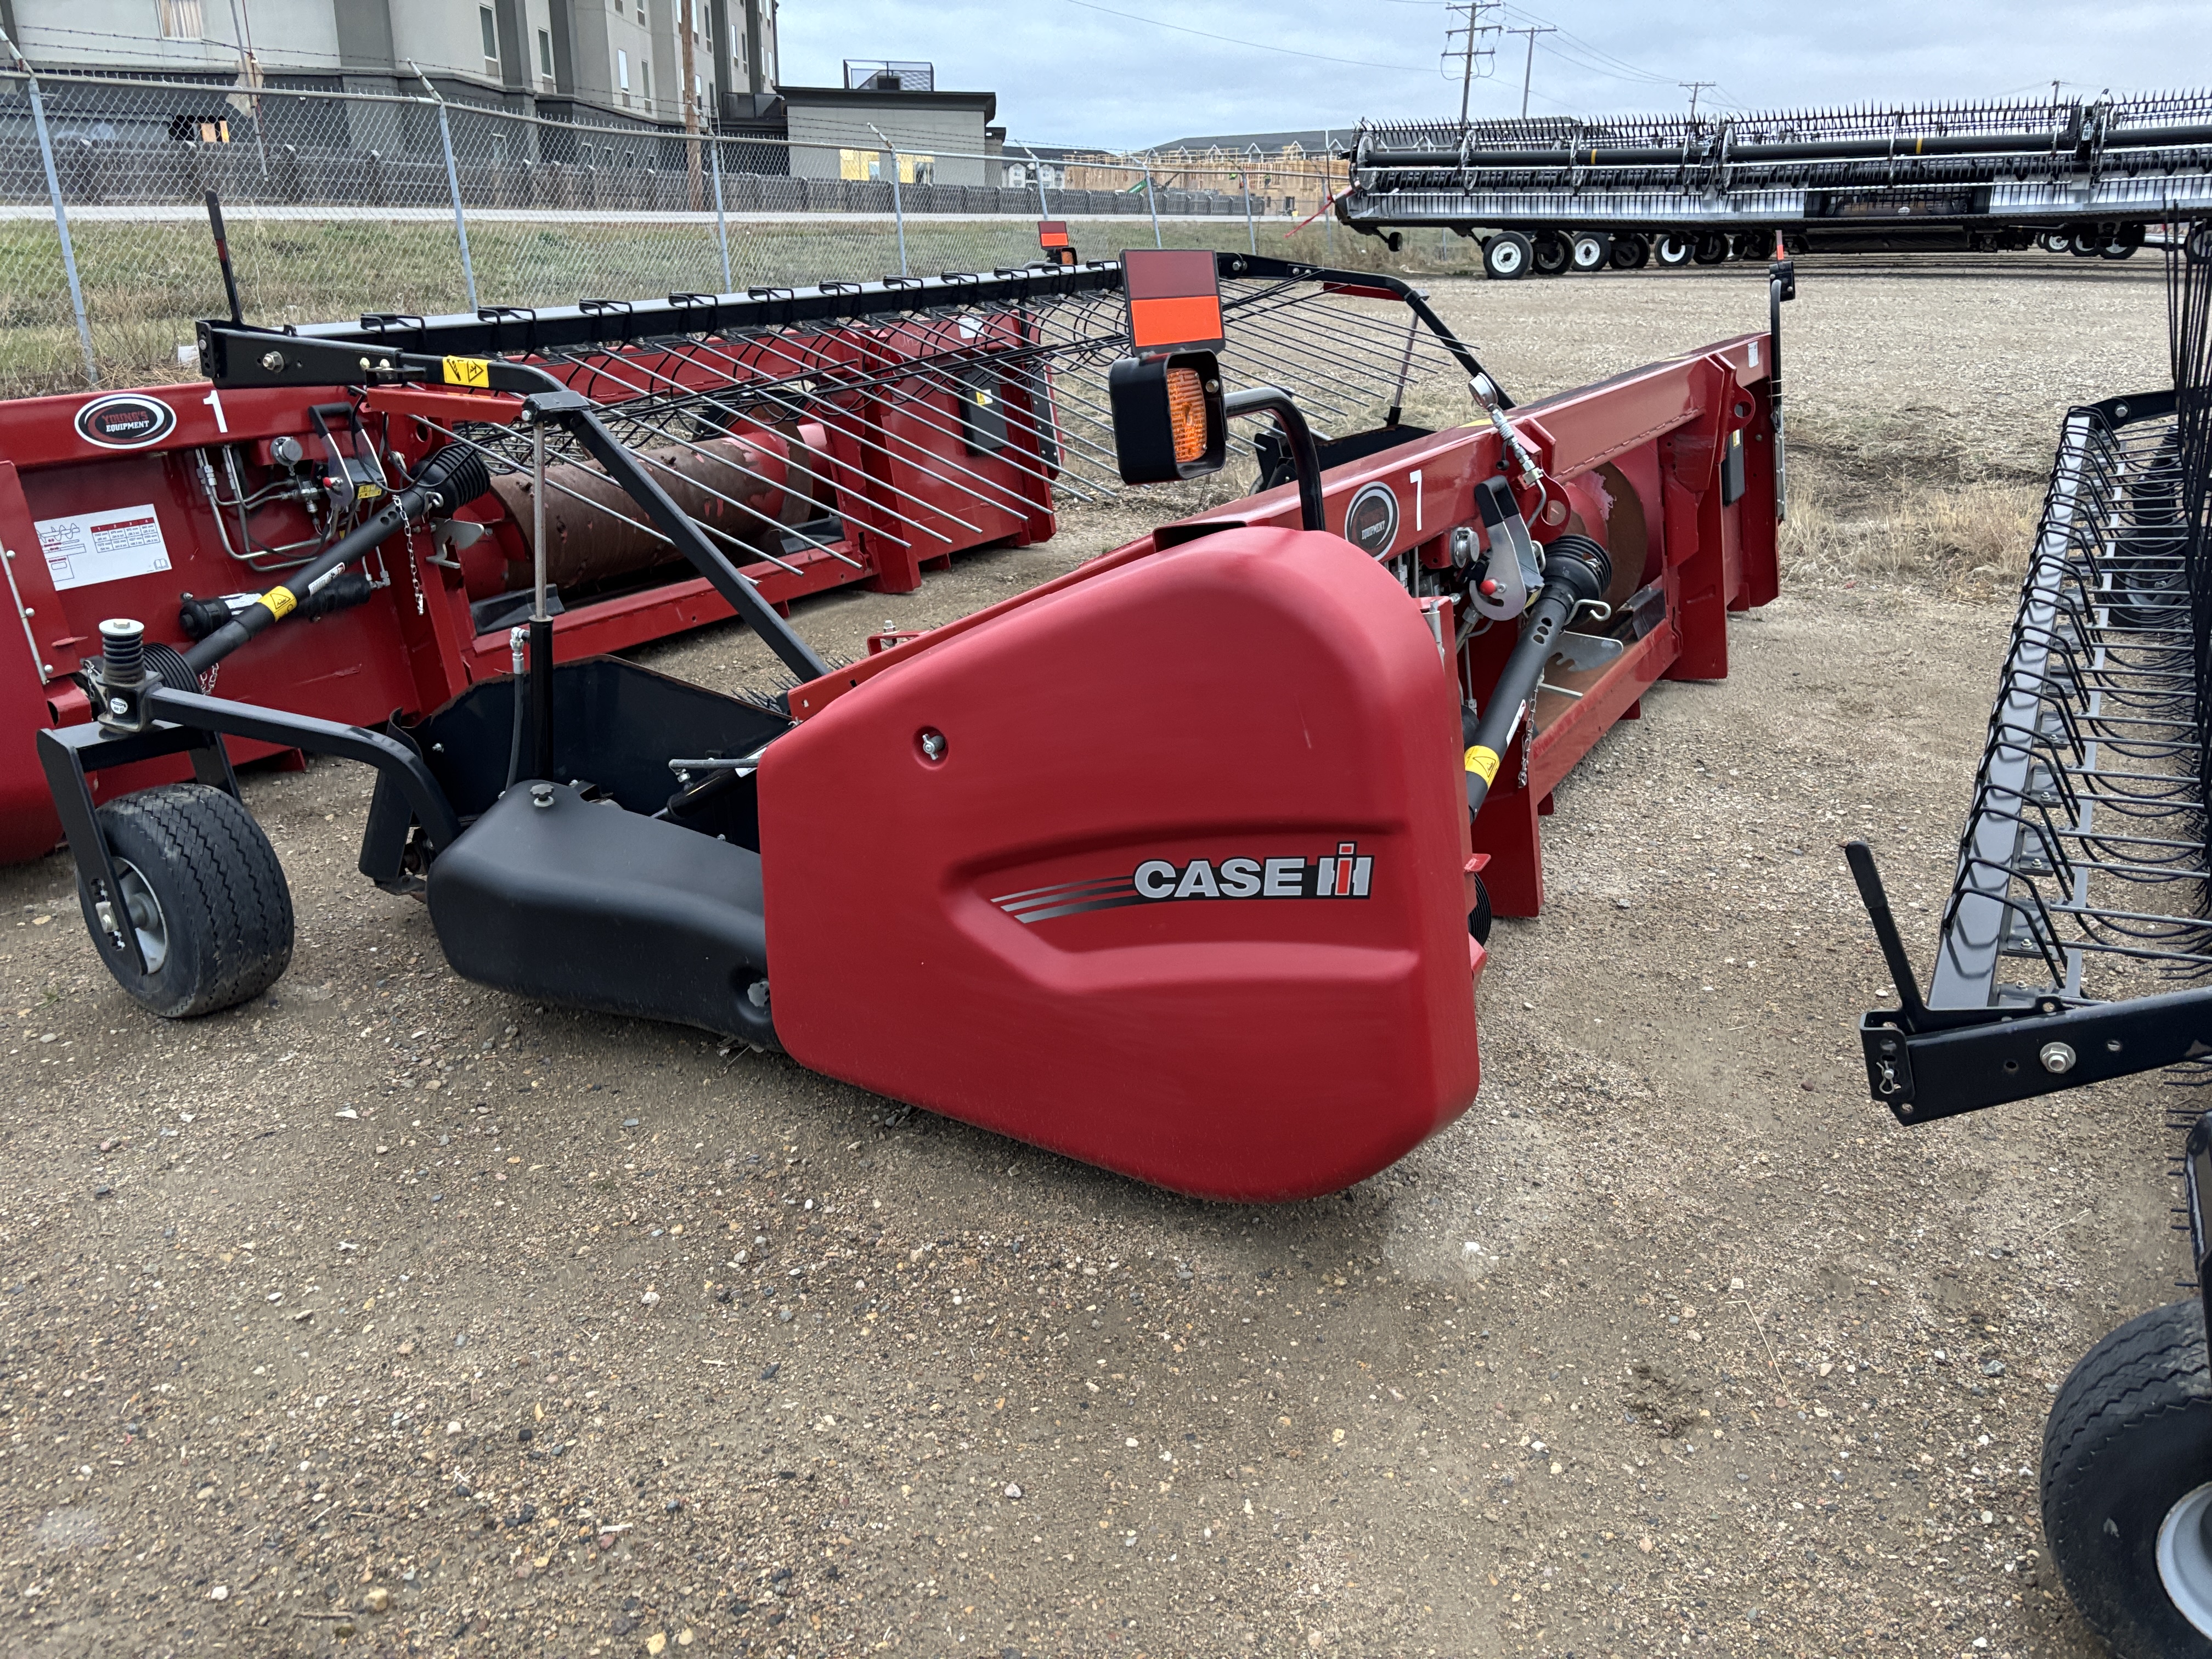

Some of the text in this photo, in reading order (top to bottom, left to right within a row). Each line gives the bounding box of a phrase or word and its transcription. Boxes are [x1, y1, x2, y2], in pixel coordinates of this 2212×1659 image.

[106, 420, 149, 432] EQUIPMENT
[203, 390, 228, 433] 1
[1409, 469, 1422, 532] 1
[1135, 857, 1305, 899] CASE
